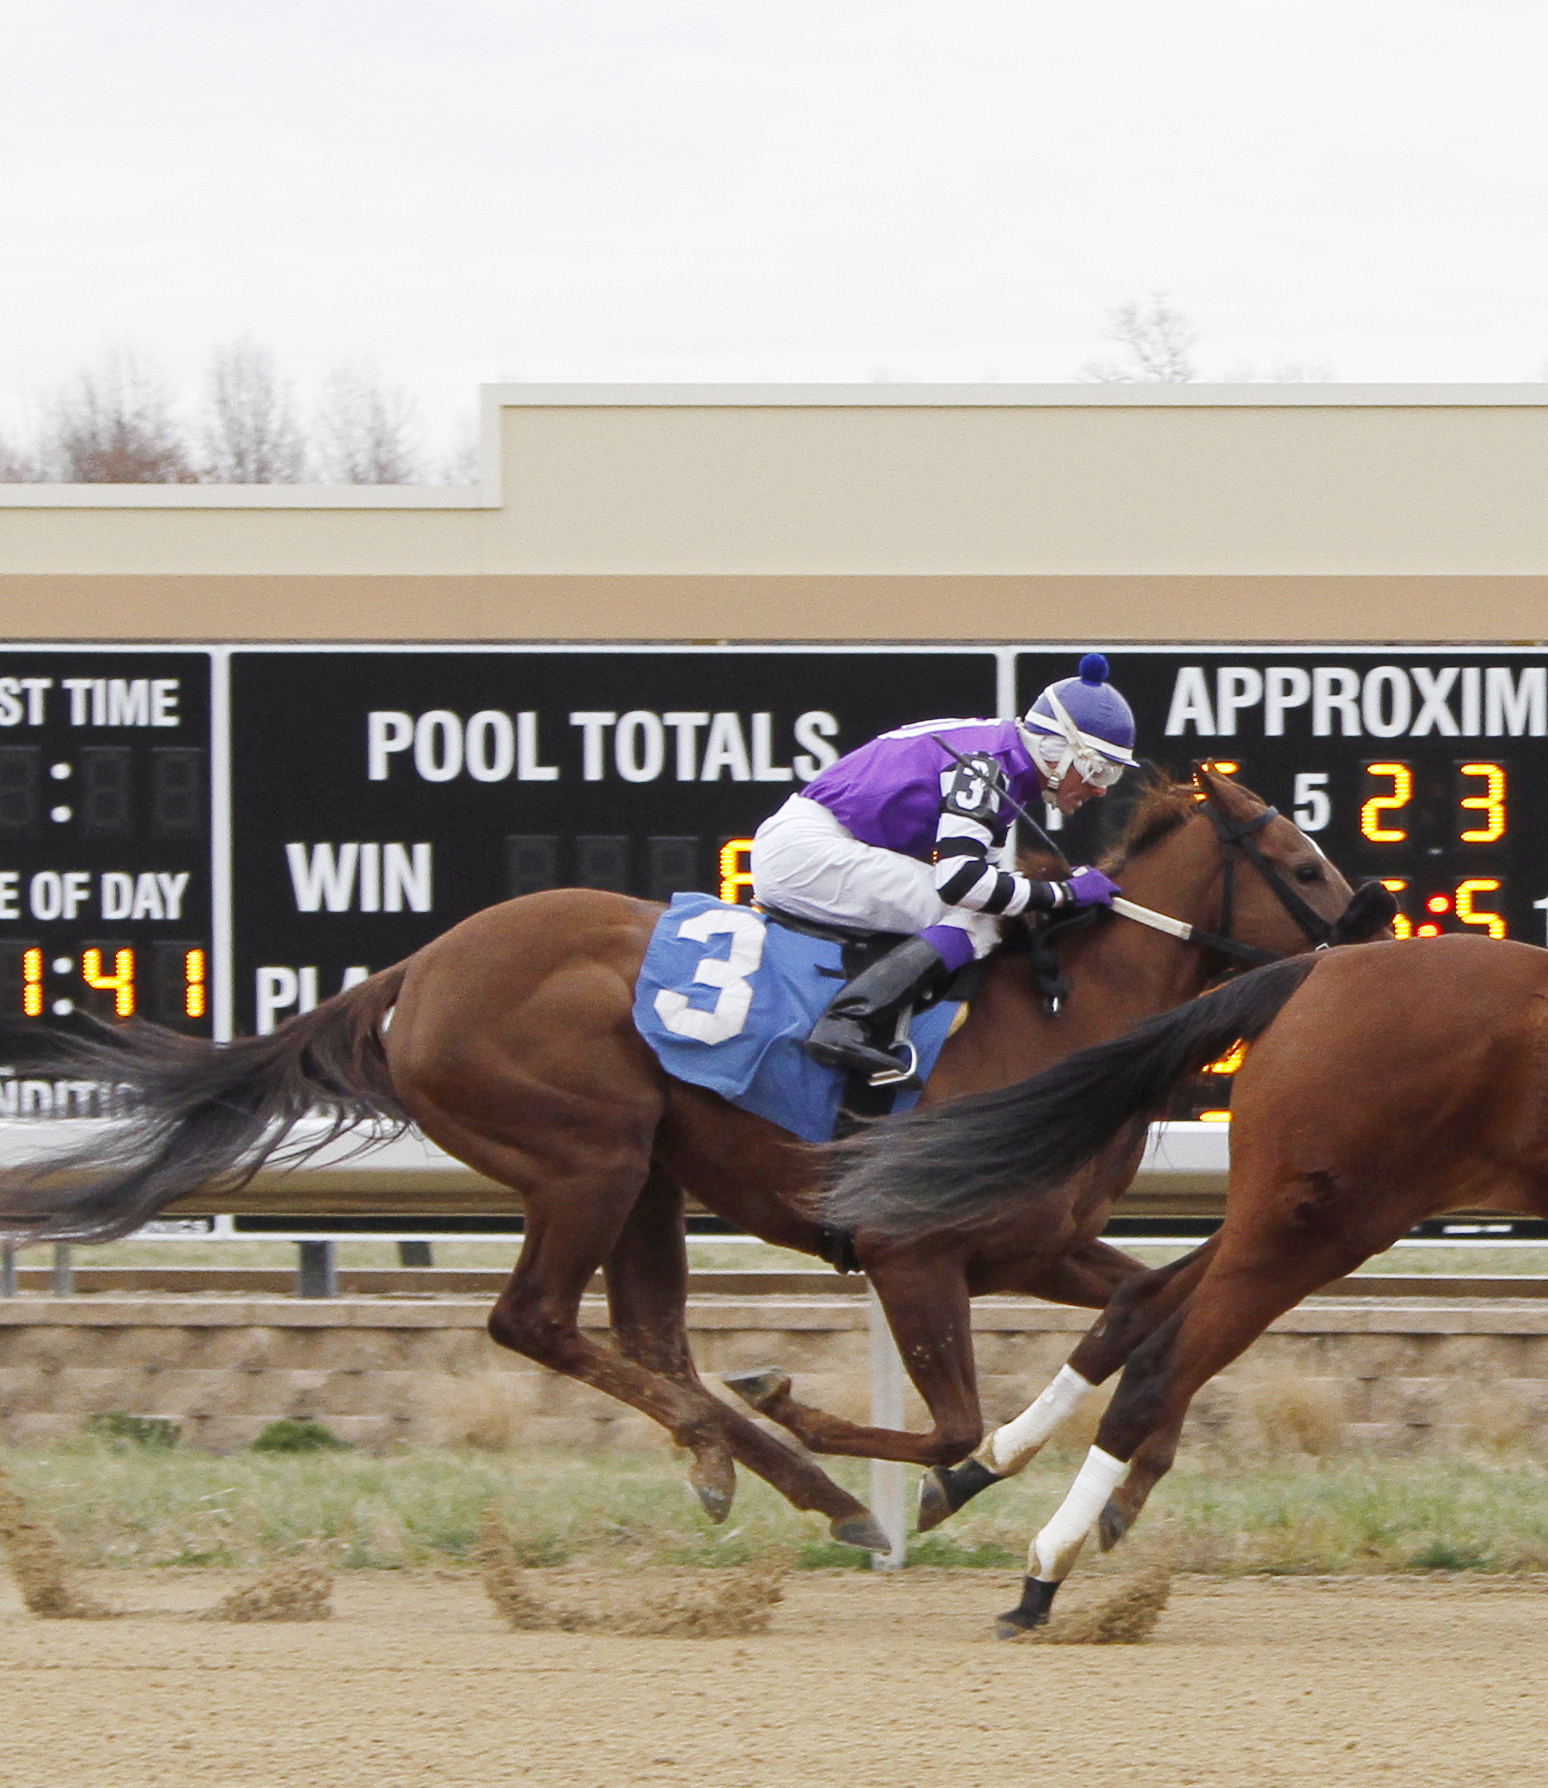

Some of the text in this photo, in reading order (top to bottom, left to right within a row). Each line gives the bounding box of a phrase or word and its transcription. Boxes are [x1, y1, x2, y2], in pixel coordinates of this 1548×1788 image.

[61, 677, 181, 727] TIME
[366, 711, 841, 783] POOL TOTALS
[955, 758, 991, 812] 3
[1293, 772, 1331, 831] 5
[30, 871, 91, 921] OF
[101, 871, 190, 921] DAY
[285, 842, 433, 912] WIN
[653, 909, 768, 1046] 3
